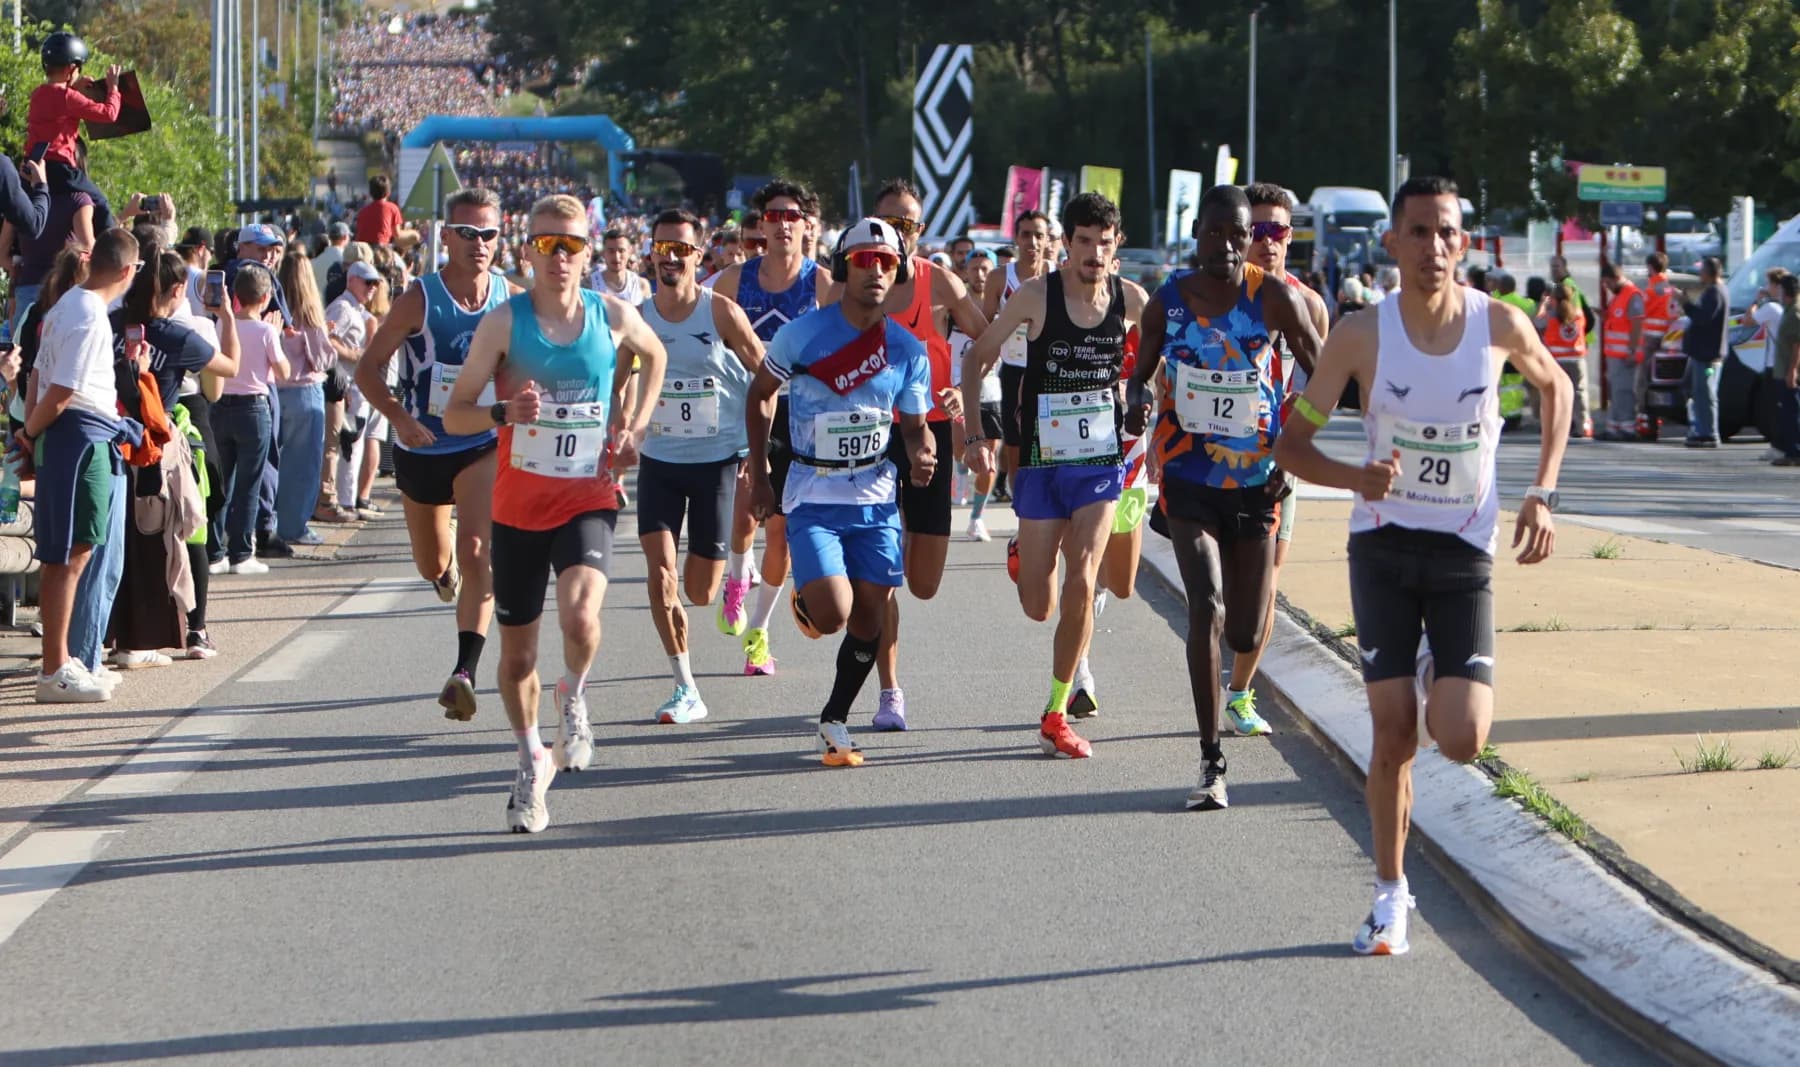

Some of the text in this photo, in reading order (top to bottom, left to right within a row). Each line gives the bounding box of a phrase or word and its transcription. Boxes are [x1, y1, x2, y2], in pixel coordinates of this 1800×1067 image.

[1051, 346, 1069, 356] TDR
[1059, 367, 1112, 380] bakertilly
[681, 402, 691, 421] 8
[1211, 396, 1235, 419] 12
[1078, 418, 1090, 440] 6
[554, 433, 577, 457] 10
[838, 432, 881, 457] 5978
[1418, 456, 1451, 486] 29
